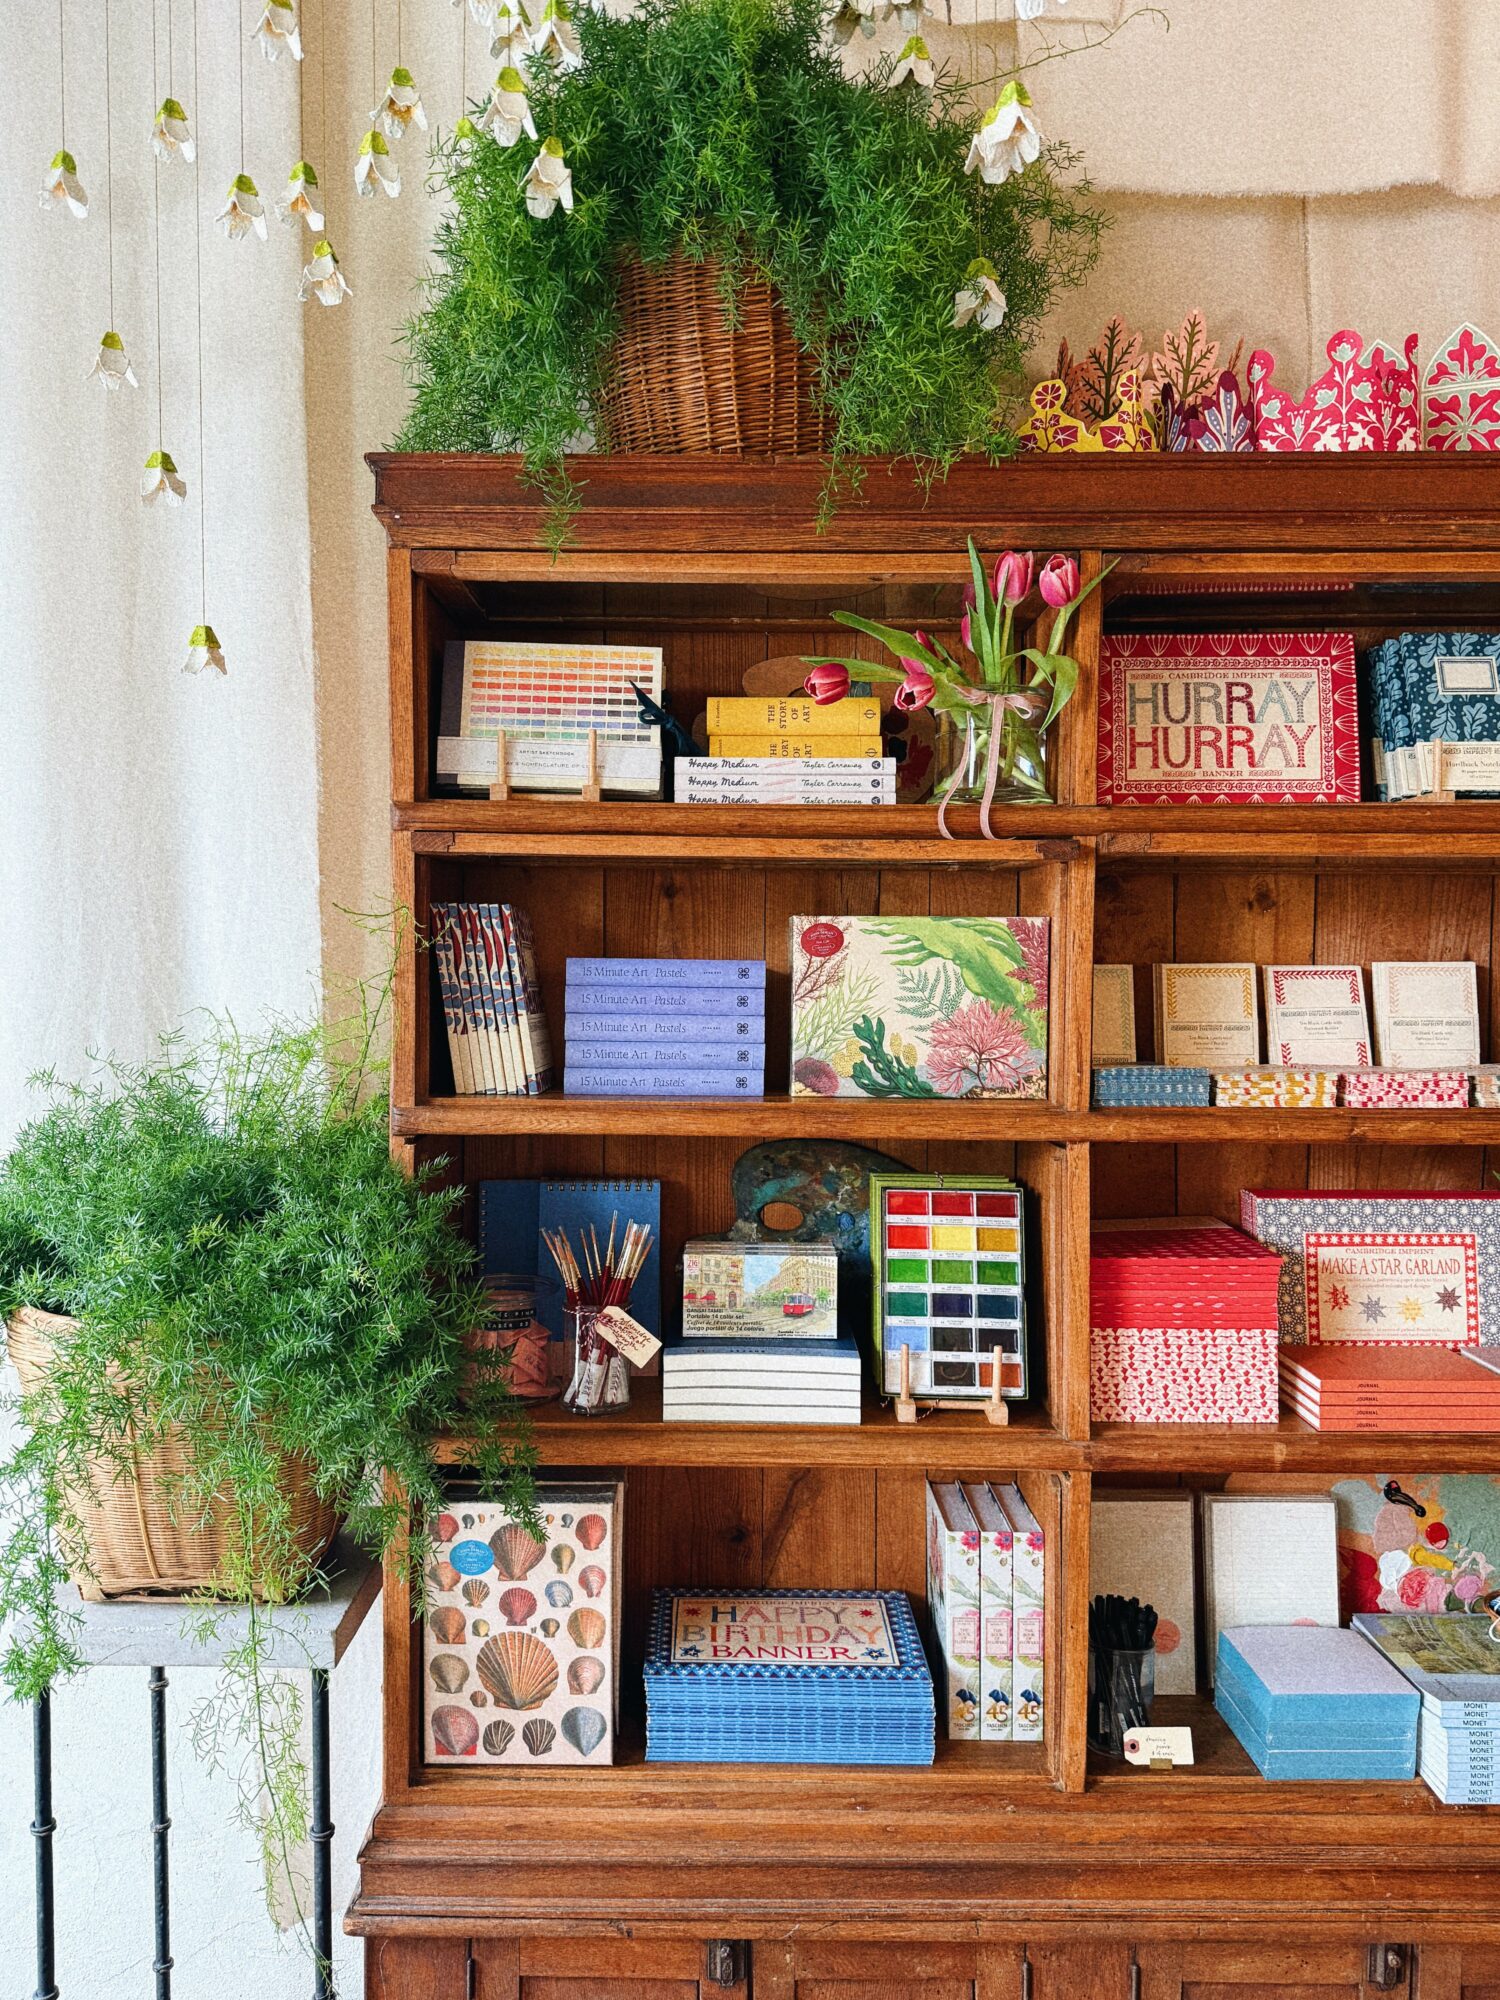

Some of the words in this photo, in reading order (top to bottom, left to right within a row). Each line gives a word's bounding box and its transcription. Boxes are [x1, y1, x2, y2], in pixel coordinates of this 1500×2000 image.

[1127, 679, 1316, 725] HURRAY
[767, 704, 775, 723] THE
[779, 700, 787, 729] STORY
[791, 708, 799, 720] OF
[803, 705, 811, 723] ART
[769, 743, 777, 757] HE
[781, 739, 789, 757] ORY
[1127, 723, 1317, 769] HURRAY
[688, 758, 719, 770] Happy
[721, 758, 759, 769] Medium
[1201, 769, 1244, 777] BANNER
[688, 776, 718, 788] Happy
[721, 776, 759, 786] Medium
[582, 966, 592, 977] 15
[593, 967, 630, 977] Minute
[632, 967, 649, 977] Art
[655, 967, 687, 978] Pastels
[581, 994, 591, 1004] 15
[593, 994, 628, 1004] Minute
[631, 995, 647, 1005] Art
[654, 995, 686, 1006] Pastels
[581, 1021, 591, 1032] 15
[593, 1022, 630, 1032] Minute
[631, 1022, 647, 1032] Art
[654, 1023, 686, 1033] Pastels
[581, 1049, 591, 1059] 15
[593, 1049, 629, 1059] Minute
[631, 1049, 647, 1060] Art
[655, 1050, 687, 1060] Pastels
[580, 1076, 590, 1086] 15
[592, 1076, 628, 1087] Minute
[630, 1077, 646, 1087] Art
[653, 1077, 685, 1088] Pastels
[1321, 1257, 1358, 1275] MAKE
[1359, 1257, 1369, 1275] A
[1371, 1258, 1403, 1275] STAR
[1405, 1258, 1461, 1275] GARLAND
[711, 1605, 849, 1624] HAPPY
[682, 1624, 882, 1645] BIRTHDAY
[712, 1645, 858, 1660] BANNER
[986, 1702, 1008, 1723] 45
[1018, 1703, 1040, 1723] 45
